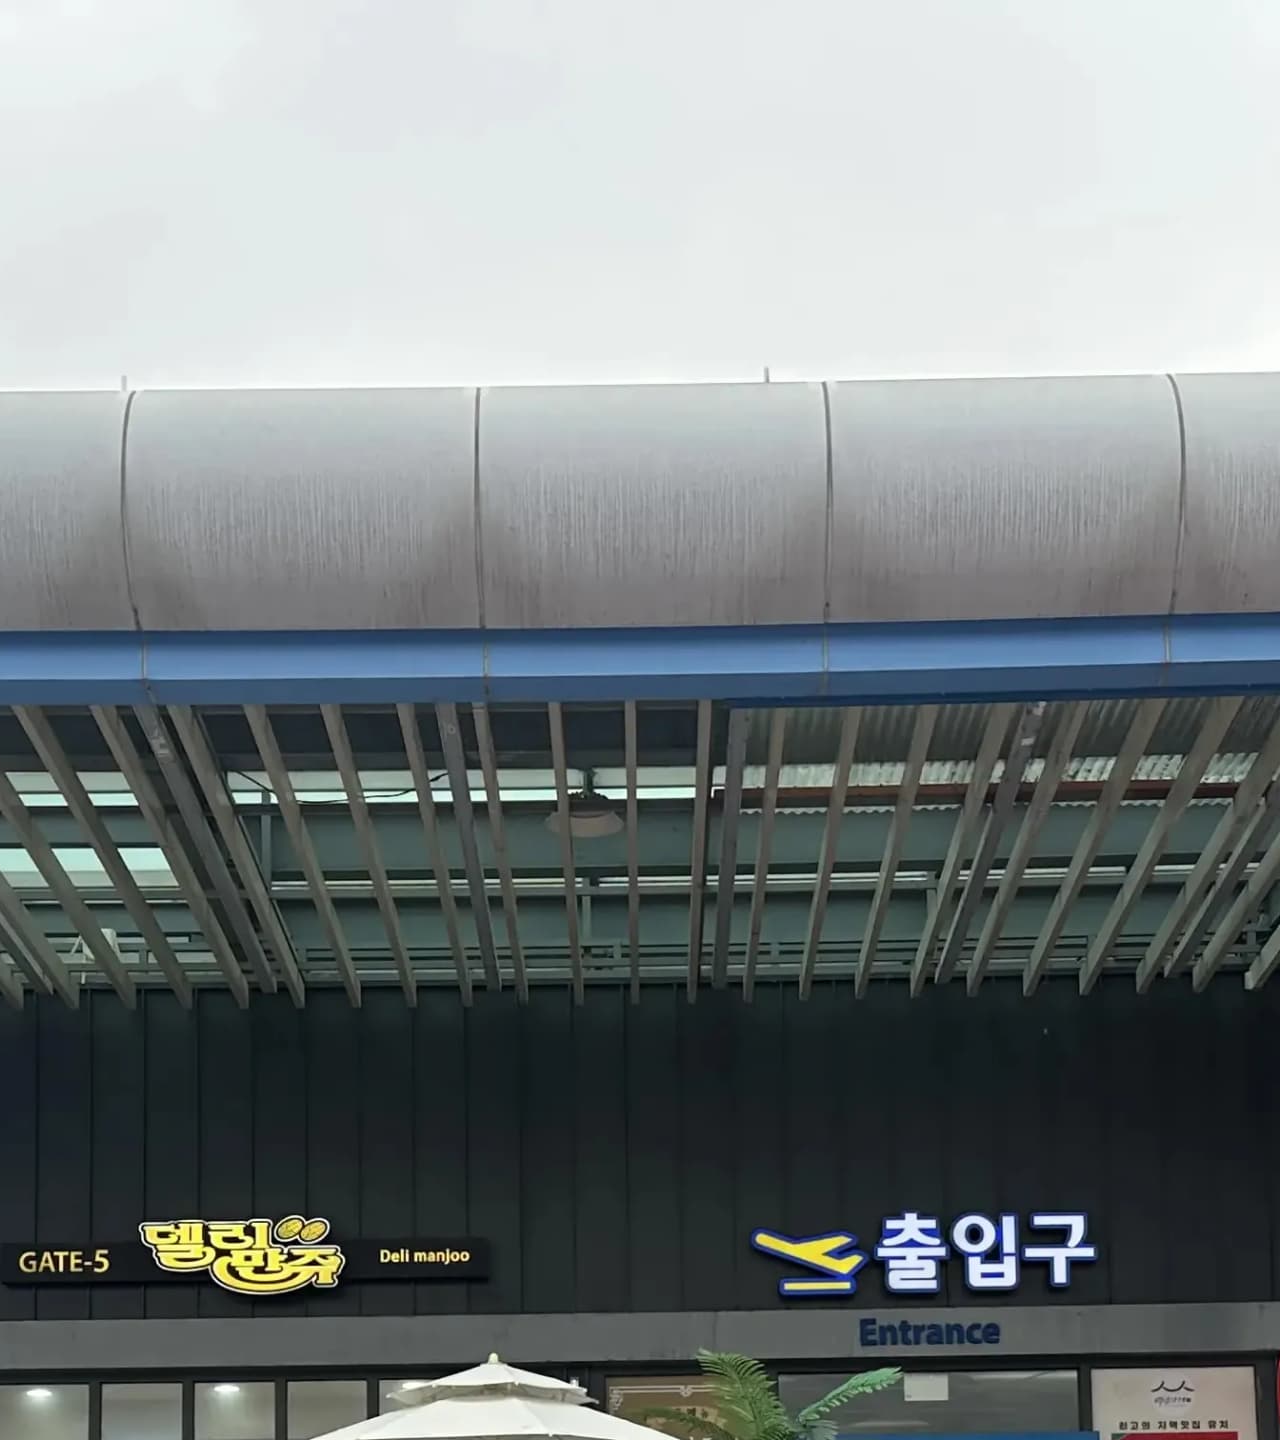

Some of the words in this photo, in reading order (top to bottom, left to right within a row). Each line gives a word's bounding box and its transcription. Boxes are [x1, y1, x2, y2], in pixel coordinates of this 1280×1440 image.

[19, 1250, 109, 1274] GATE-5
[379, 1248, 409, 1264] Deli
[413, 1248, 469, 1266] manjoo
[876, 1211, 1097, 1293] 출입구
[859, 1319, 1000, 1346] Entrance
